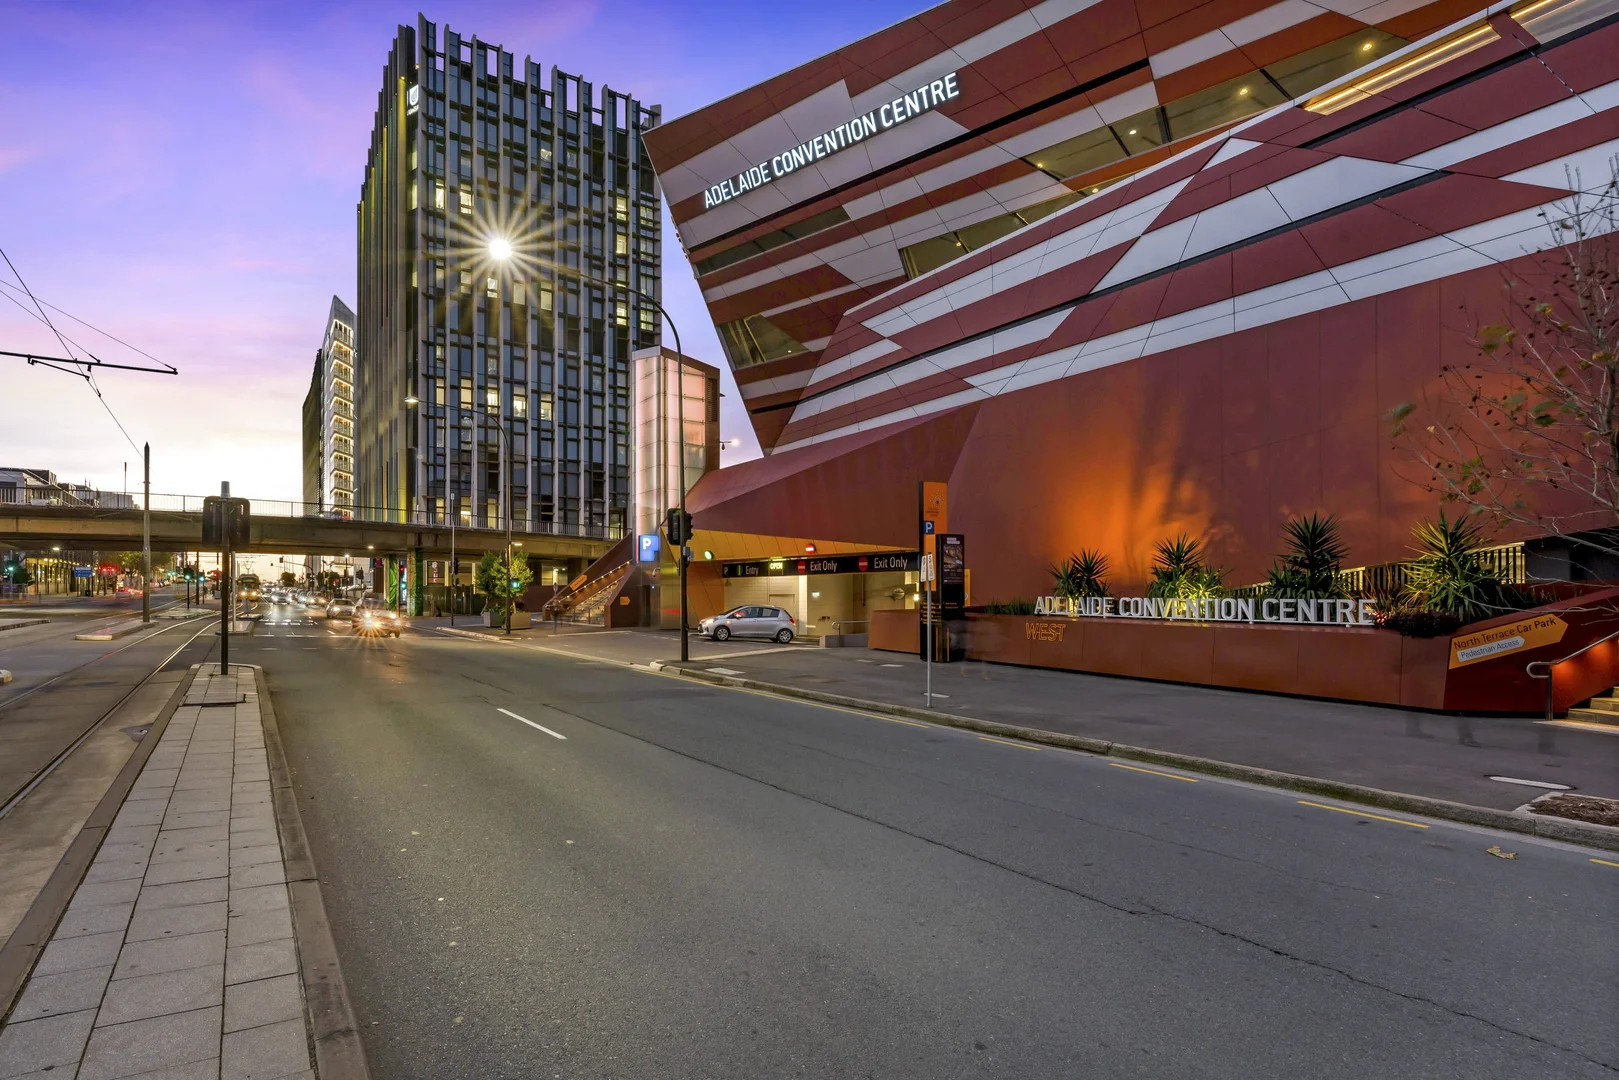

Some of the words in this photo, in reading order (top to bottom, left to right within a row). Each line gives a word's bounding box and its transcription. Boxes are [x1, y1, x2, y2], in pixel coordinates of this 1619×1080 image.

[704, 162, 771, 209] ADELAIDE
[772, 111, 877, 176] CONVENTION
[880, 72, 960, 128] CENTRE
[925, 521, 933, 533] P
[642, 537, 652, 550] P
[745, 565, 759, 575] Entry
[769, 562, 783, 570] OPEN
[809, 561, 822, 572] Exit
[822, 560, 838, 573] Only
[874, 557, 888, 569] Exit
[889, 556, 908, 570] Only
[1034, 596, 1115, 616] ADELAIDE
[1118, 597, 1255, 621] CONVENTION
[1262, 598, 1378, 625] CENTRE
[1025, 622, 1067, 642] WEST
[1453, 638, 1481, 650] North
[1481, 628, 1515, 643] Terrace
[1516, 624, 1532, 634] Car
[1534, 617, 1557, 630] Park
[1460, 644, 1497, 659] Pedestrian
[1497, 639, 1520, 650] Access
